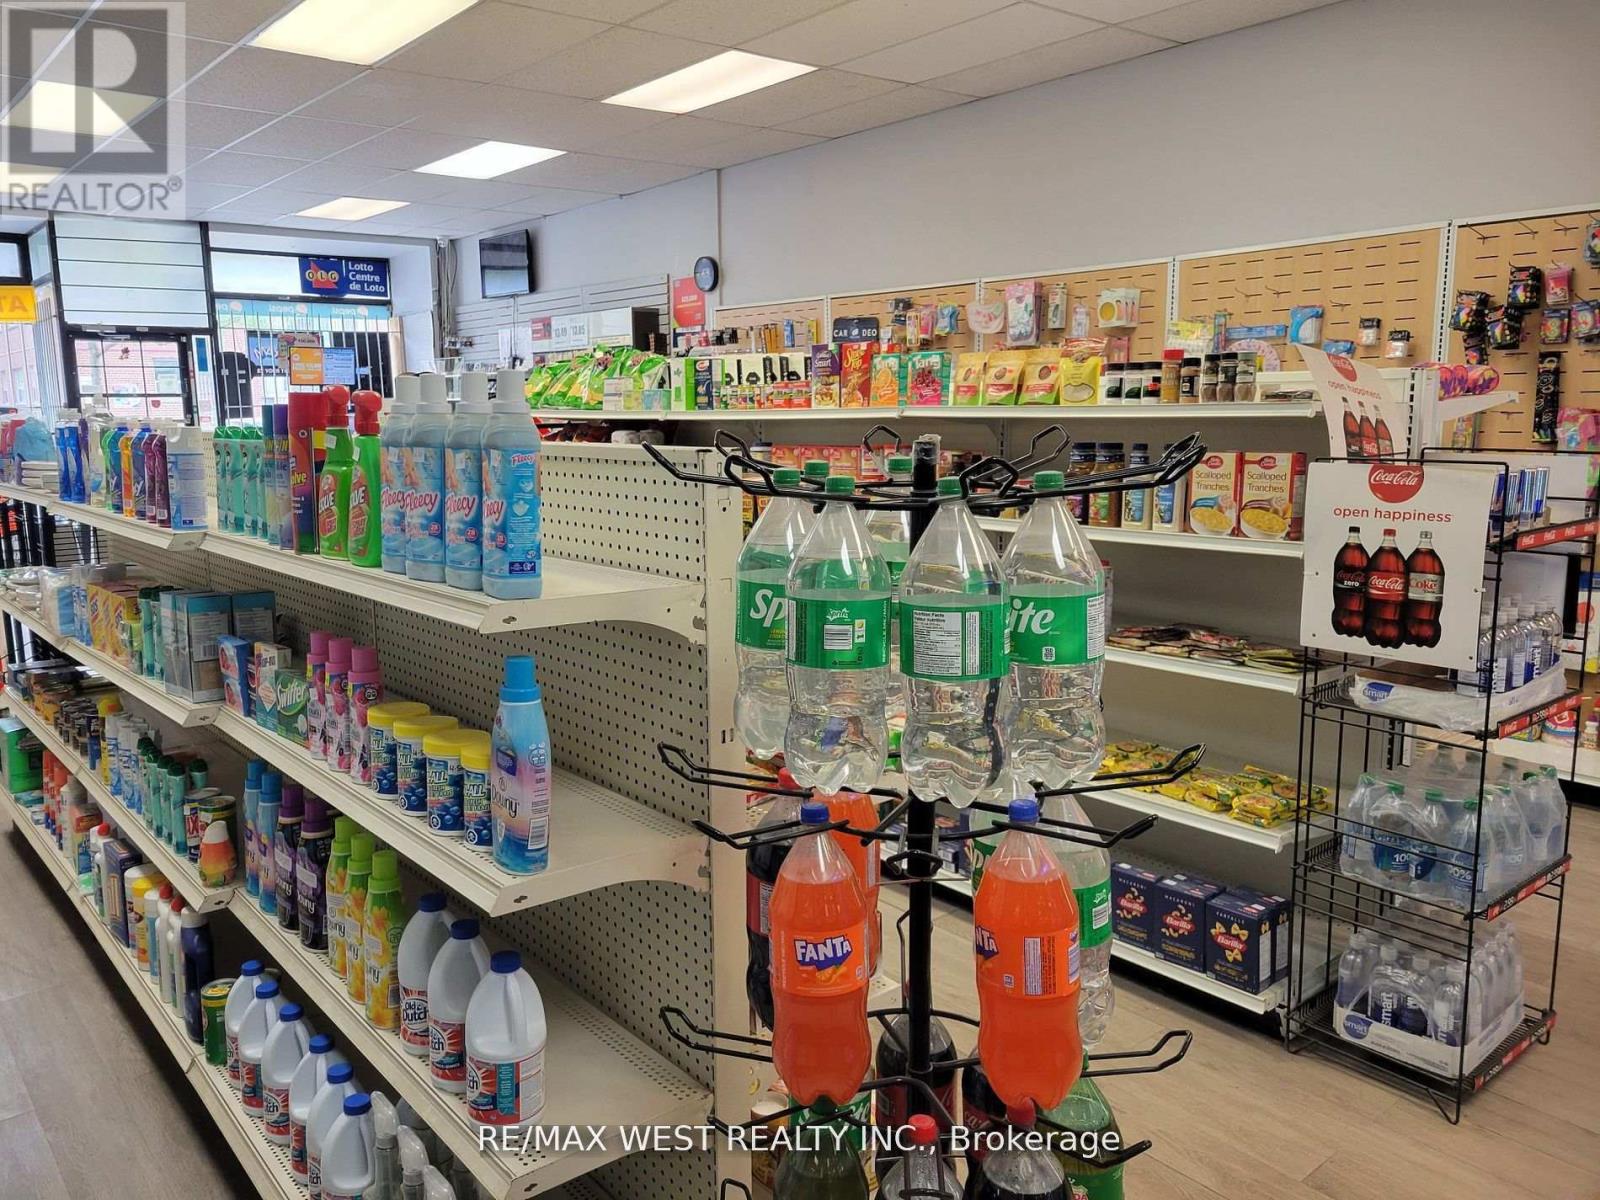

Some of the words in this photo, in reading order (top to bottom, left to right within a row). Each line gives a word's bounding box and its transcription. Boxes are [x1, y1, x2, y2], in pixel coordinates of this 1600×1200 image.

[348, 261, 374, 272] Lotto
[305, 270, 339, 282] OLG
[348, 272, 381, 282] Centre
[349, 281, 361, 291] de
[364, 282, 385, 293] Loto
[833, 329, 849, 338] CAR
[862, 328, 878, 337] DEO
[1195, 470, 1231, 481] Scalloped
[1247, 470, 1287, 482] Scalloped
[1370, 469, 1419, 486] Coca-Cola
[1196, 481, 1230, 491] Tranches
[1247, 482, 1285, 494] Tranches
[1333, 506, 1370, 519] open
[1374, 507, 1452, 523] happiness
[1368, 575, 1405, 591] Coca-Cola
[1409, 578, 1438, 591] Coke
[794, 935, 852, 963] FANTA
[404, 1001, 416, 1011] Old
